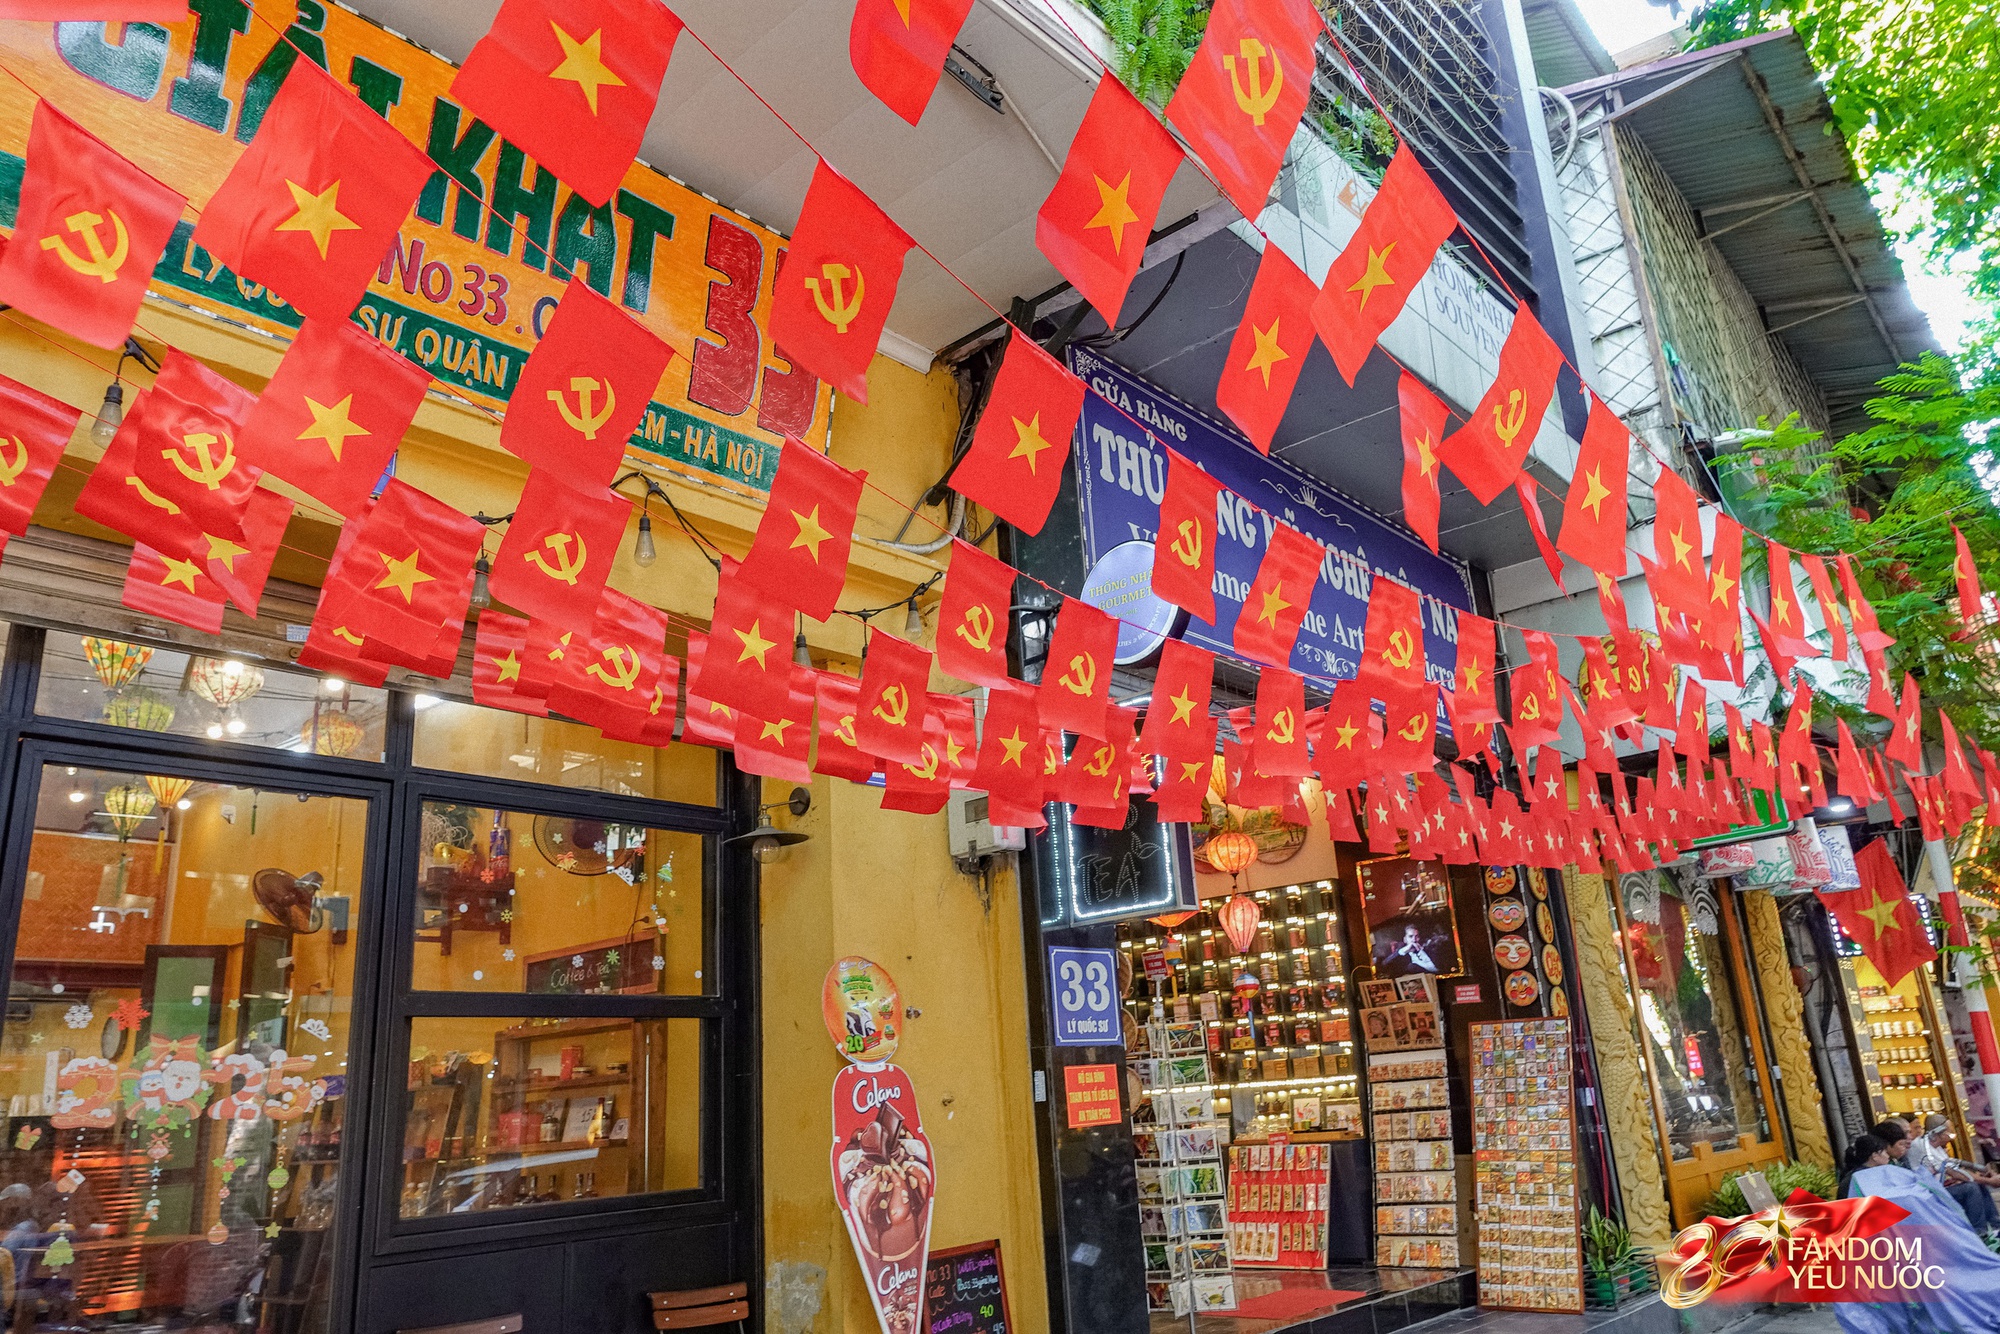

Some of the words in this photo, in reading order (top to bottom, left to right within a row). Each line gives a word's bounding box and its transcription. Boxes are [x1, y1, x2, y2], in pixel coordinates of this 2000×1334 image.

[415, 328, 510, 391] QUẬN
[1092, 376, 1133, 413] CỬA
[1136, 400, 1188, 441] HÀNG
[684, 425, 719, 465] HÀ
[1093, 422, 1165, 505] THỦ
[1077, 852, 1139, 906] TEA
[551, 969, 585, 989] Coffee
[1060, 960, 1111, 1012] 33
[845, 1035, 866, 1053] 20
[1067, 1017, 1077, 1033] LÝ
[1077, 1016, 1097, 1035] QUỐC
[1098, 1019, 1109, 1033] SƯ
[852, 1076, 901, 1114] Celano
[876, 1262, 918, 1296] Celano
[980, 1304, 994, 1318] 40
